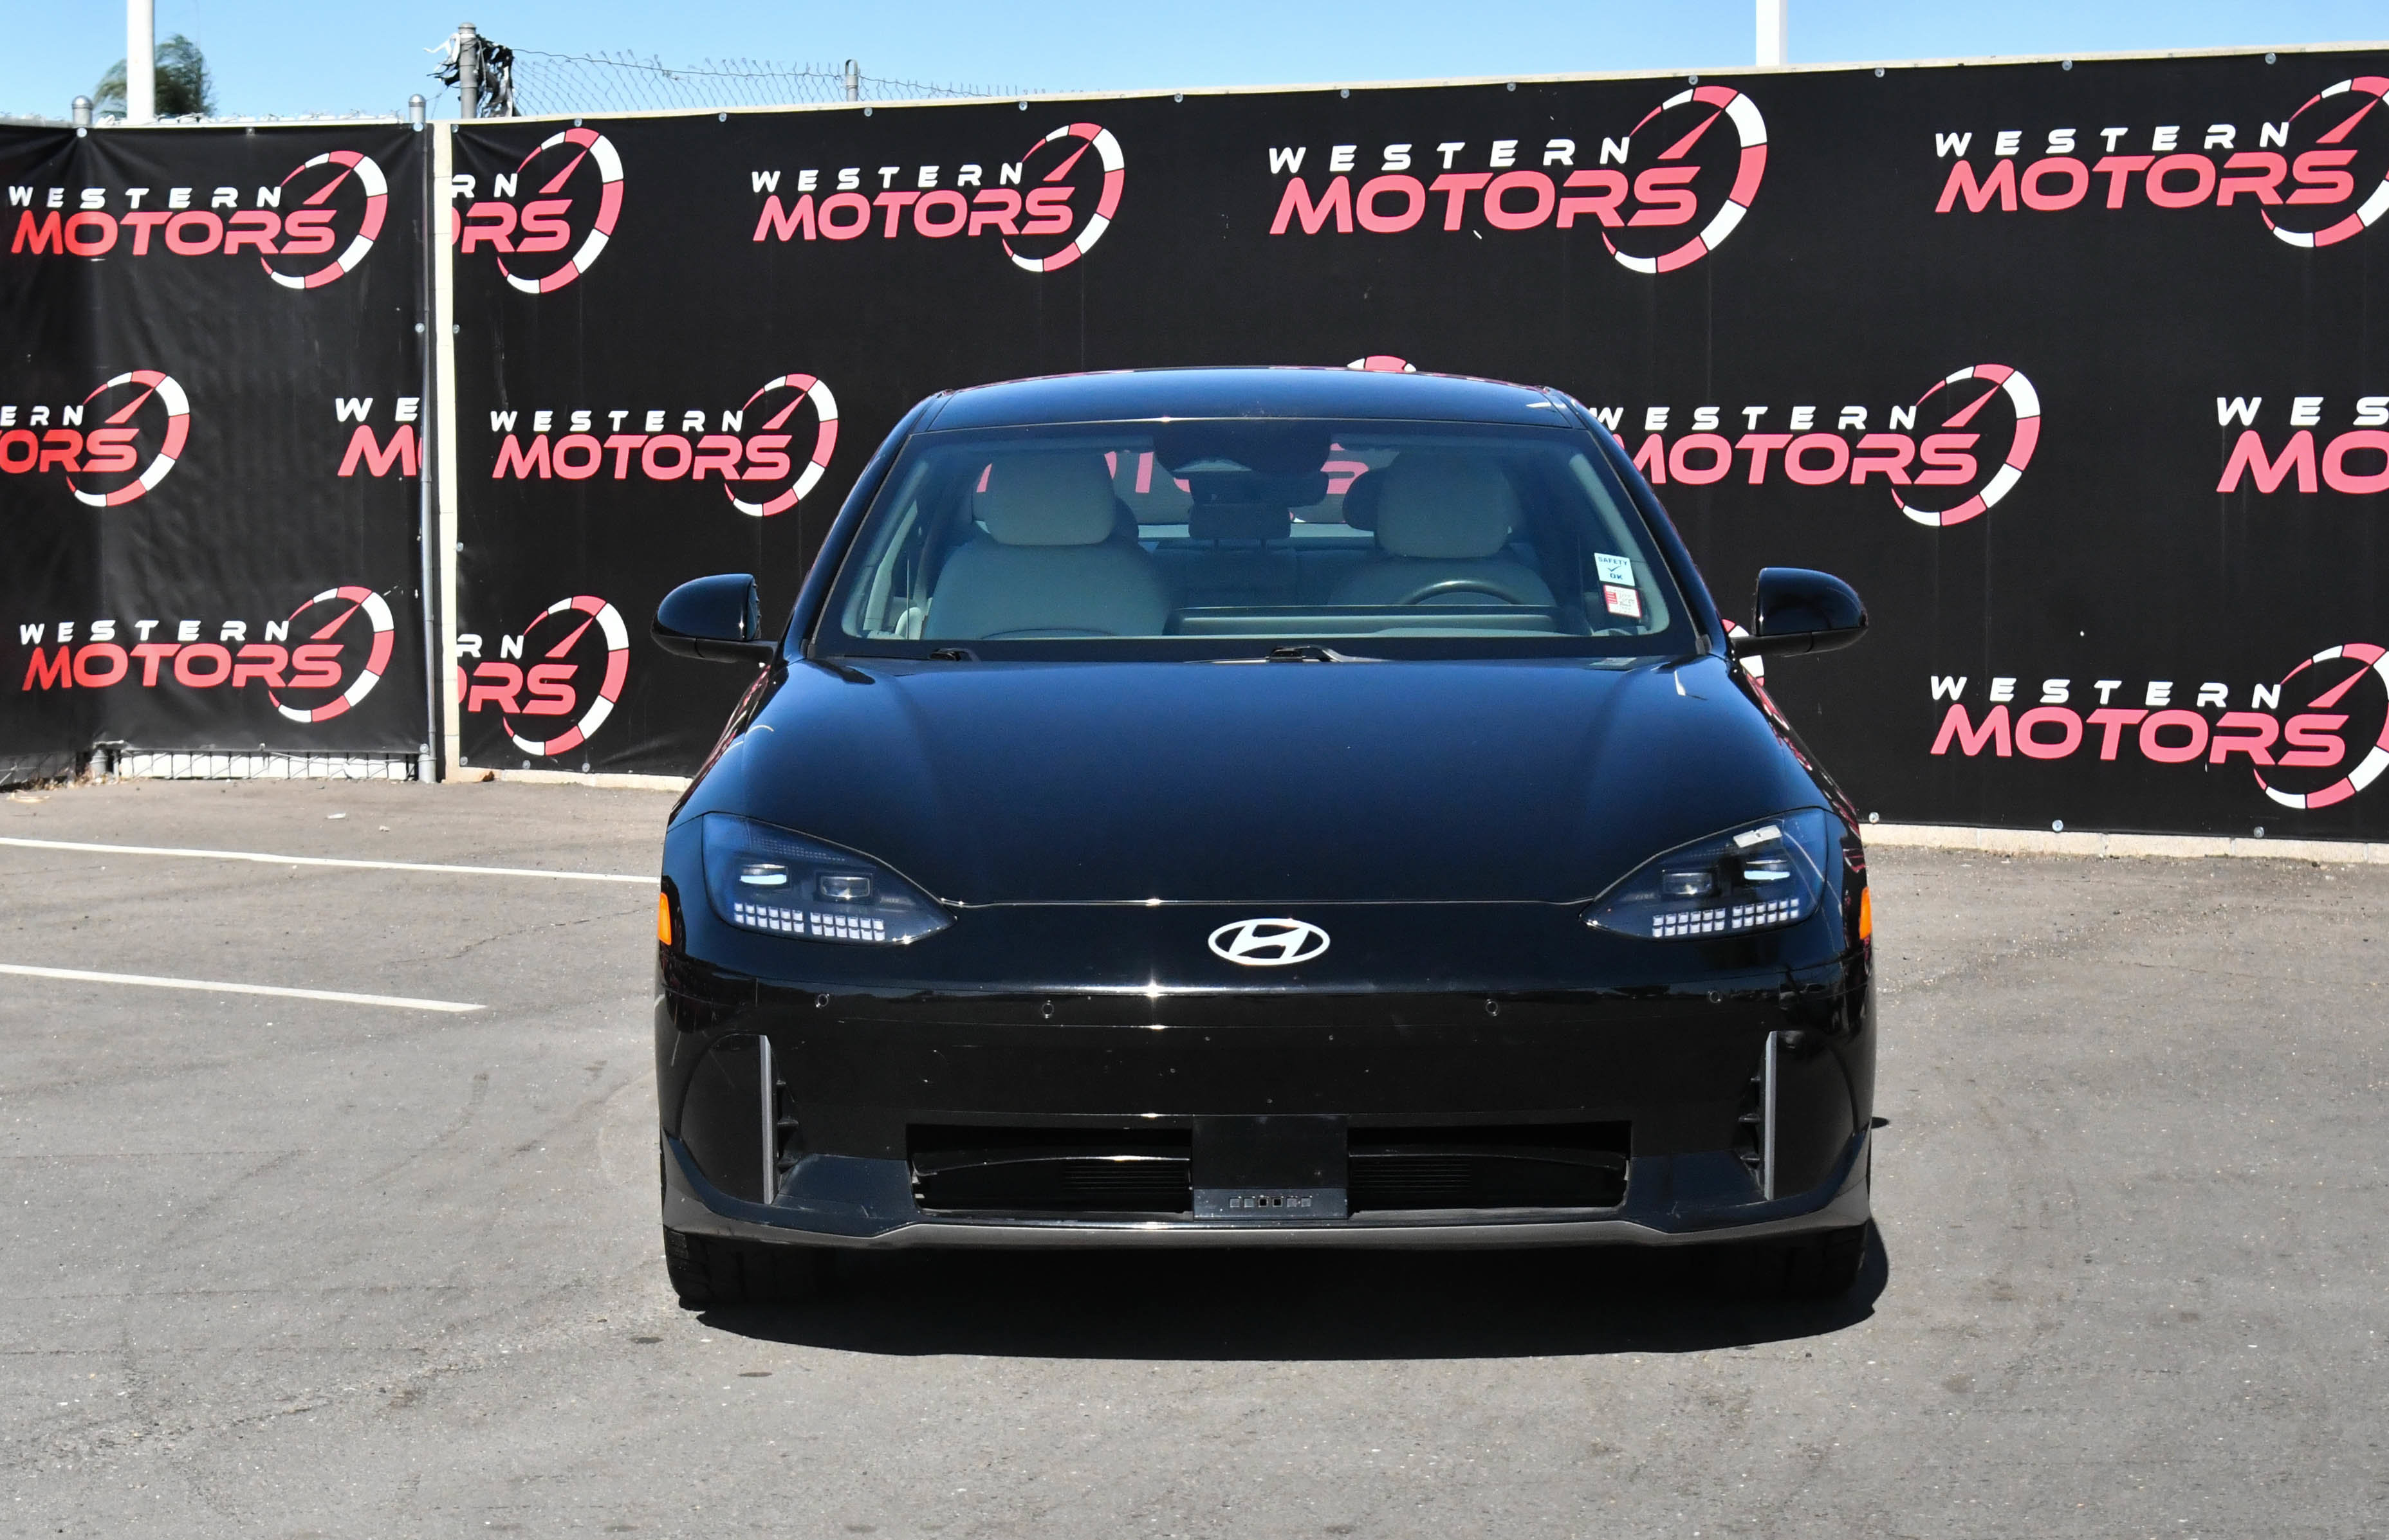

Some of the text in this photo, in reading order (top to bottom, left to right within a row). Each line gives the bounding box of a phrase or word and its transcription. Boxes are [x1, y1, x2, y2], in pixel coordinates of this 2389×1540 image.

[1268, 136, 1631, 174] WESTERN
[1935, 121, 2289, 158] WESTERN
[751, 162, 1023, 193] WESTERN
[1935, 148, 2359, 214] MOTORS
[8, 186, 282, 209] WESTERN
[753, 186, 1075, 243] MOTORS
[1269, 165, 1702, 235] MOTORS
[10, 209, 338, 257] MOTORS
[0, 405, 84, 426] ERN
[335, 397, 420, 423] WE
[490, 410, 744, 433] WESTERN
[1589, 406, 1917, 431] WESTERN
[2217, 396, 2389, 426] WES
[337, 424, 423, 477] M
[491, 433, 793, 481] MOTORS
[2215, 429, 2389, 495] MO
[1598, 556, 1627, 566] SAFETY
[19, 619, 290, 645] WESTERN
[457, 633, 524, 659] RN
[22, 643, 345, 692] MOTORS
[1930, 675, 2282, 710] WESTERN
[1930, 702, 2350, 768] MOTORS
